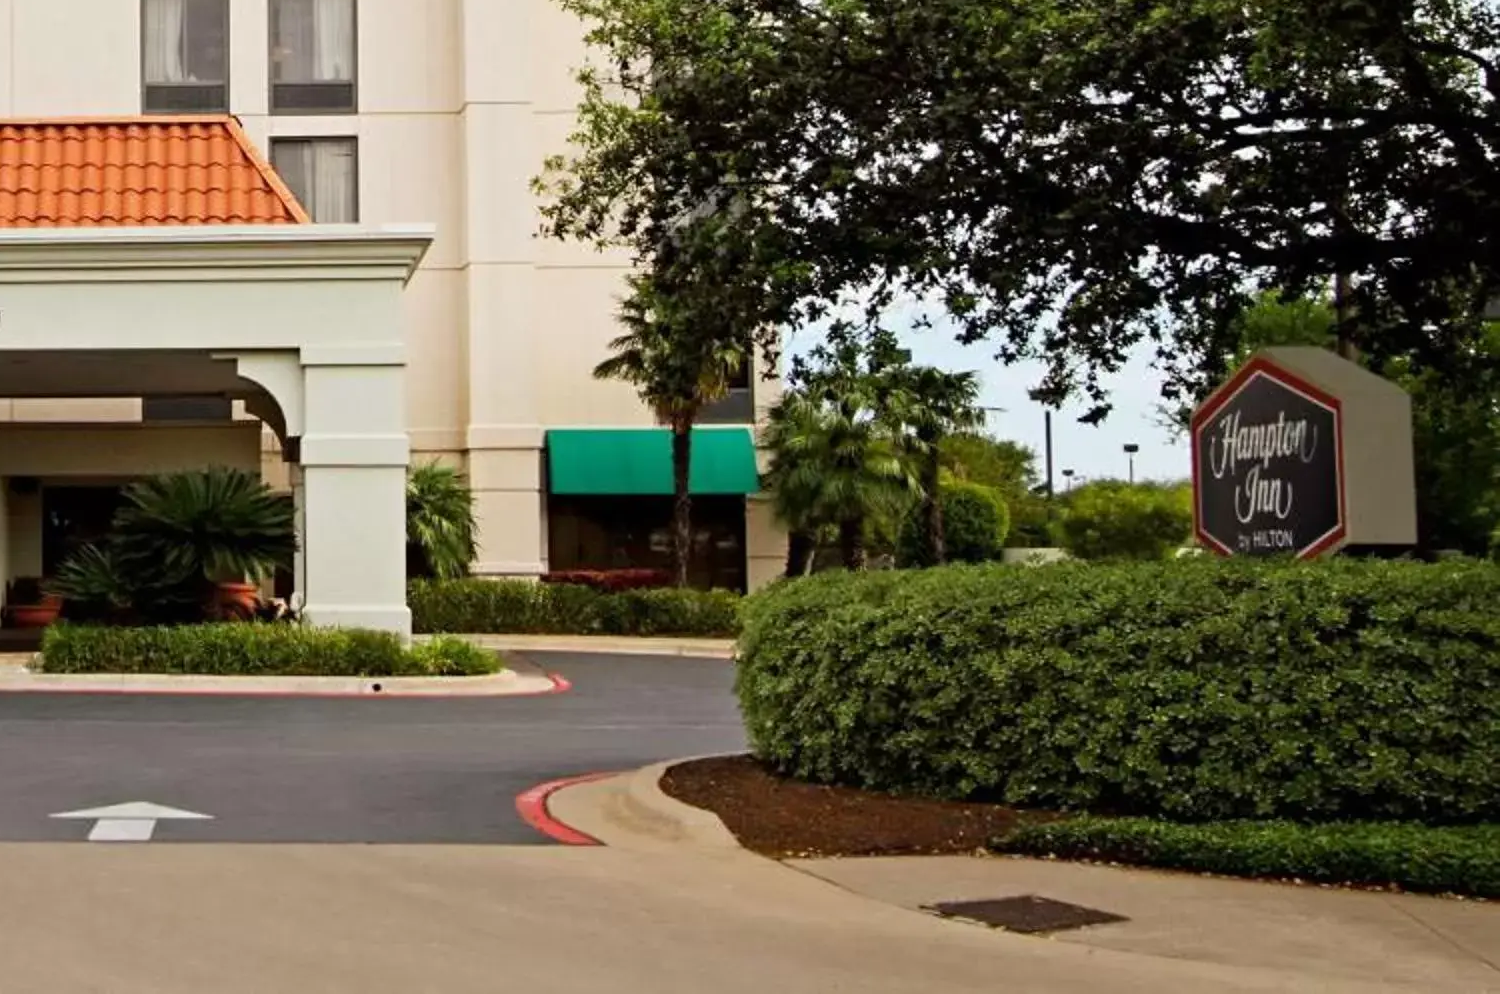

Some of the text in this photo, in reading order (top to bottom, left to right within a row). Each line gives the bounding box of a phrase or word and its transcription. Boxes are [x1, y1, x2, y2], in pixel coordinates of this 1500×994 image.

[1210, 410, 1317, 479] Hampton
[1235, 465, 1293, 523] Inn
[1253, 529, 1293, 547] HILTON
